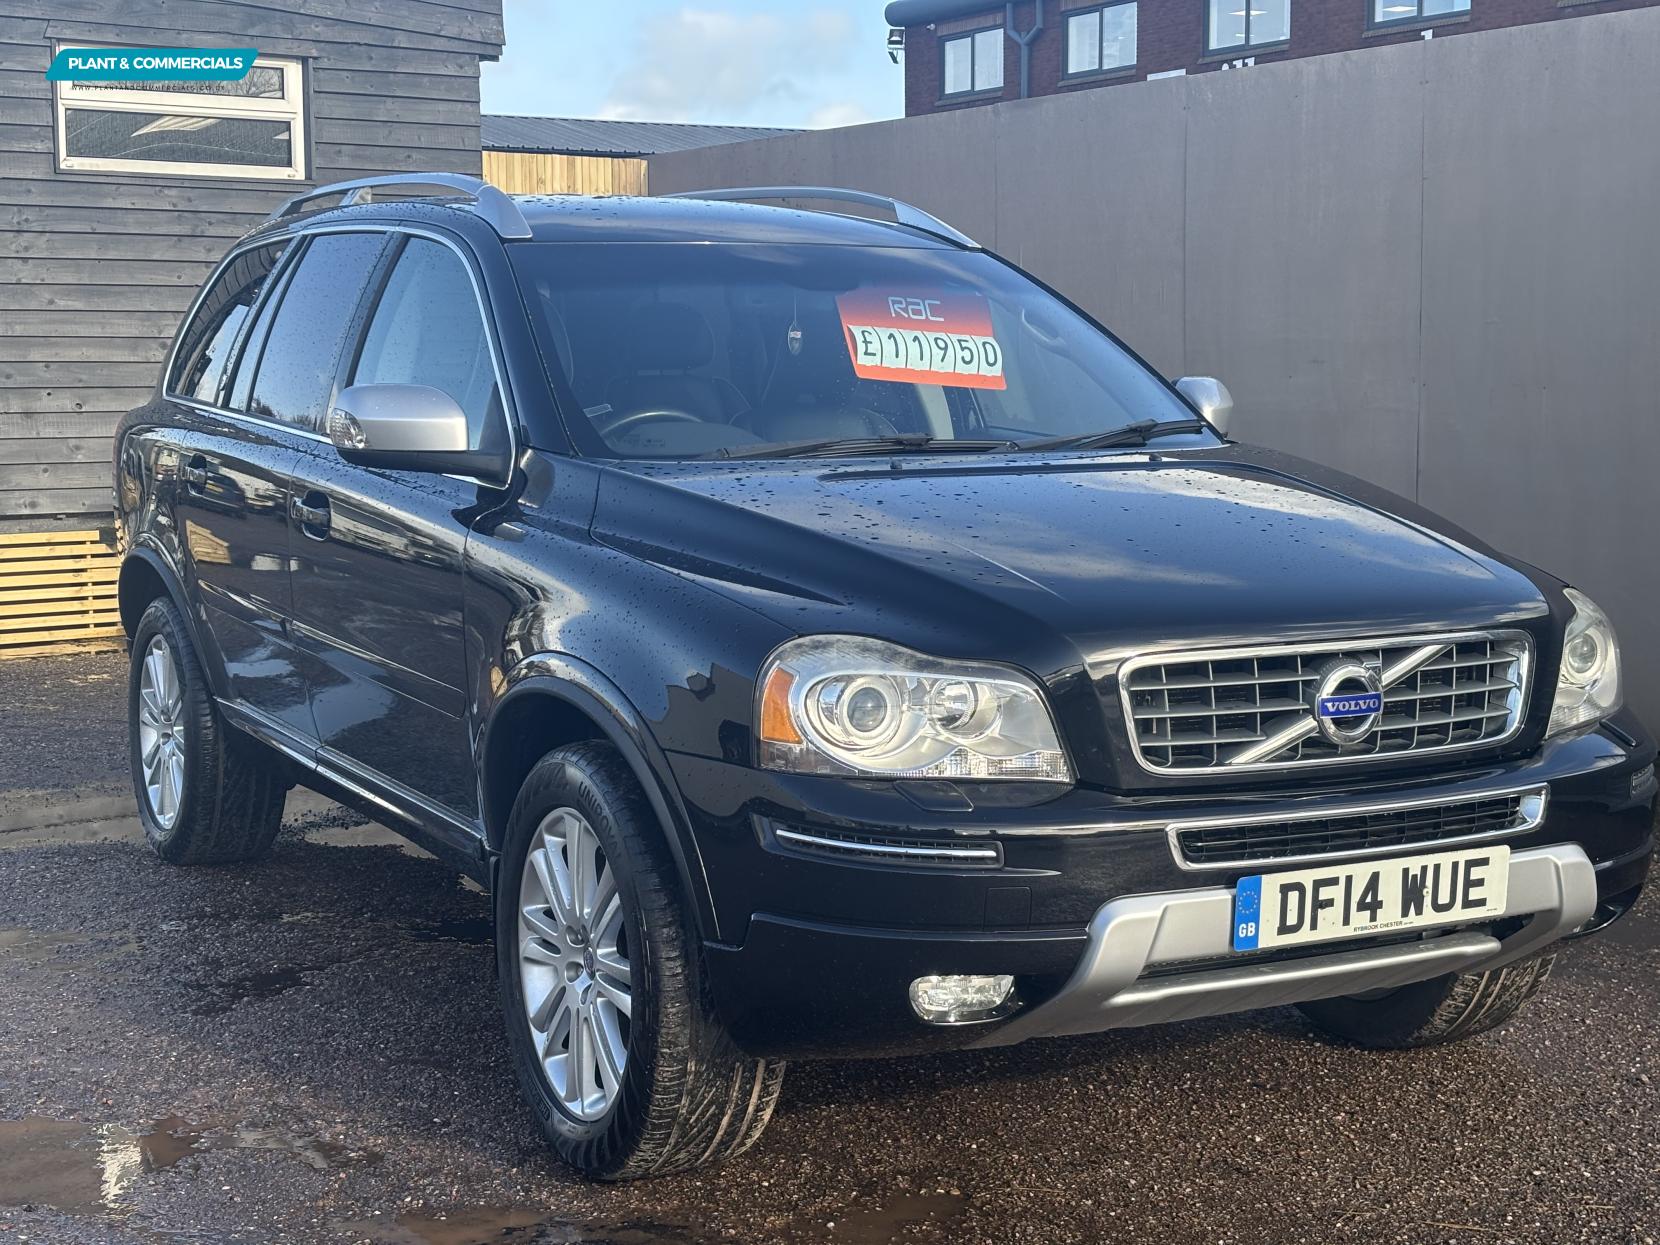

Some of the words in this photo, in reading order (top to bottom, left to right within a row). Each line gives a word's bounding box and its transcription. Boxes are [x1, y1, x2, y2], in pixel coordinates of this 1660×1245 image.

[861, 330, 998, 367] £11950
[1324, 699, 1379, 712] VOLVO
[1277, 871, 1384, 936] DF14
[1401, 857, 1490, 919] WUE
[1238, 922, 1256, 938] GB
[1379, 920, 1403, 929] CHESTER
